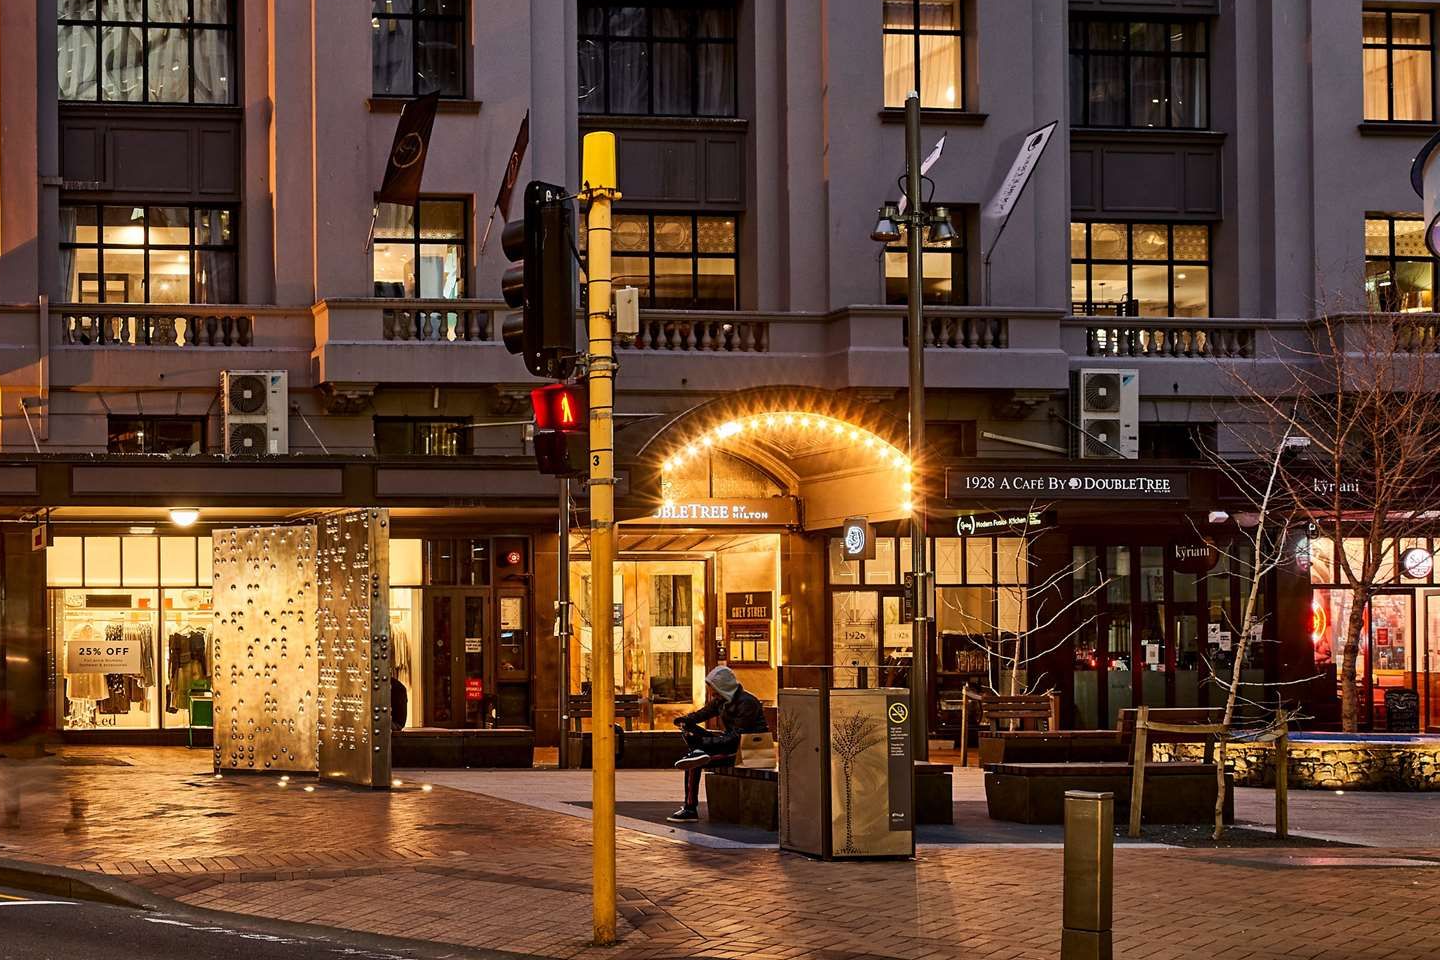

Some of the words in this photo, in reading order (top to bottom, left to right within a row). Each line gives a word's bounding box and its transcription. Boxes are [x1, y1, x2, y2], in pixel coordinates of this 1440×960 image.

[592, 455, 600, 466] 3
[965, 476, 995, 489] 1928
[1000, 478, 1012, 489] A
[745, 594, 753, 605] 28
[731, 606, 746, 618] GREY
[747, 606, 767, 618] STREET
[845, 631, 866, 640] 1928
[79, 647, 102, 656] 25%
[106, 647, 129, 656] OFF
